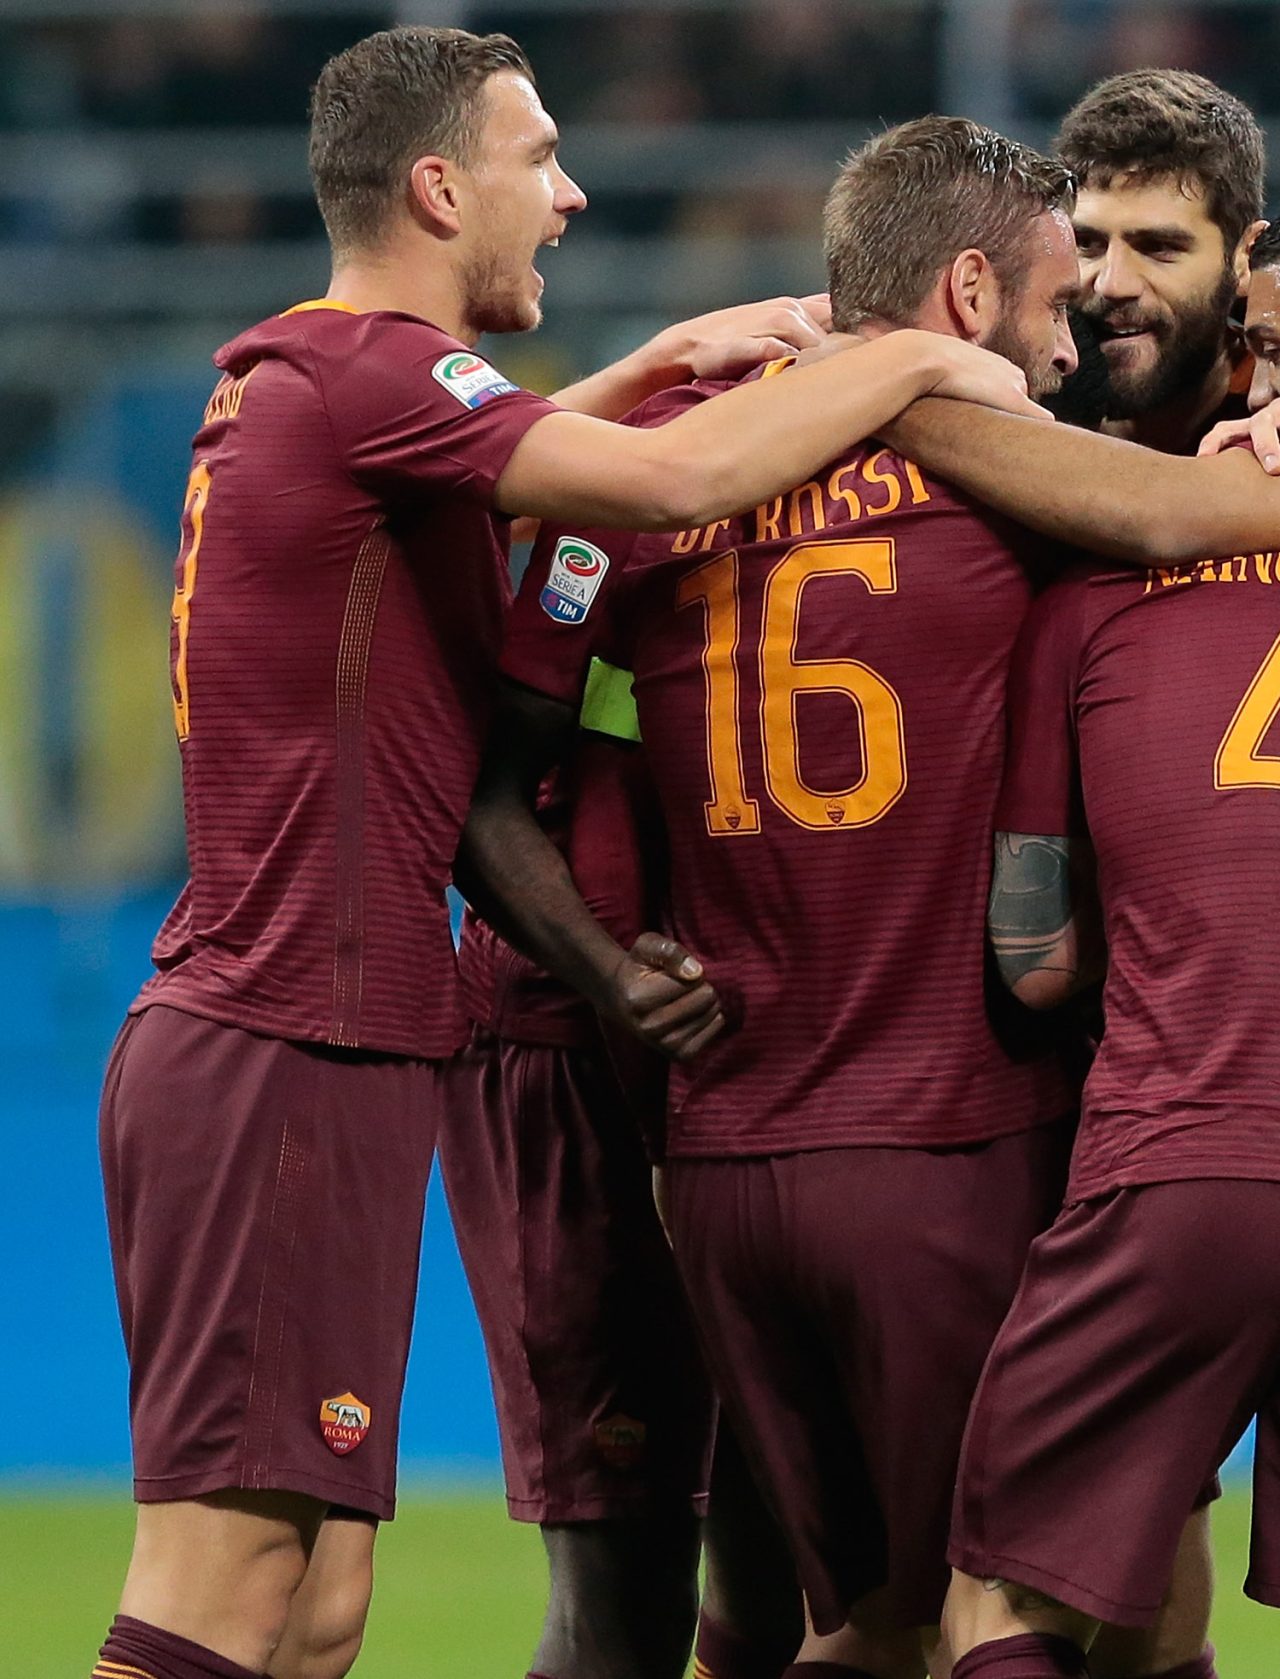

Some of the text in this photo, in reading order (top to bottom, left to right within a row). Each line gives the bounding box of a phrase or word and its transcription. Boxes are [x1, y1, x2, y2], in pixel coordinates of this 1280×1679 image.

[552, 573, 579, 596] SERIE
[577, 588, 586, 600] A
[557, 599, 578, 619] TIM
[674, 536, 908, 837] 16
[324, 1426, 361, 1441] ROMA
